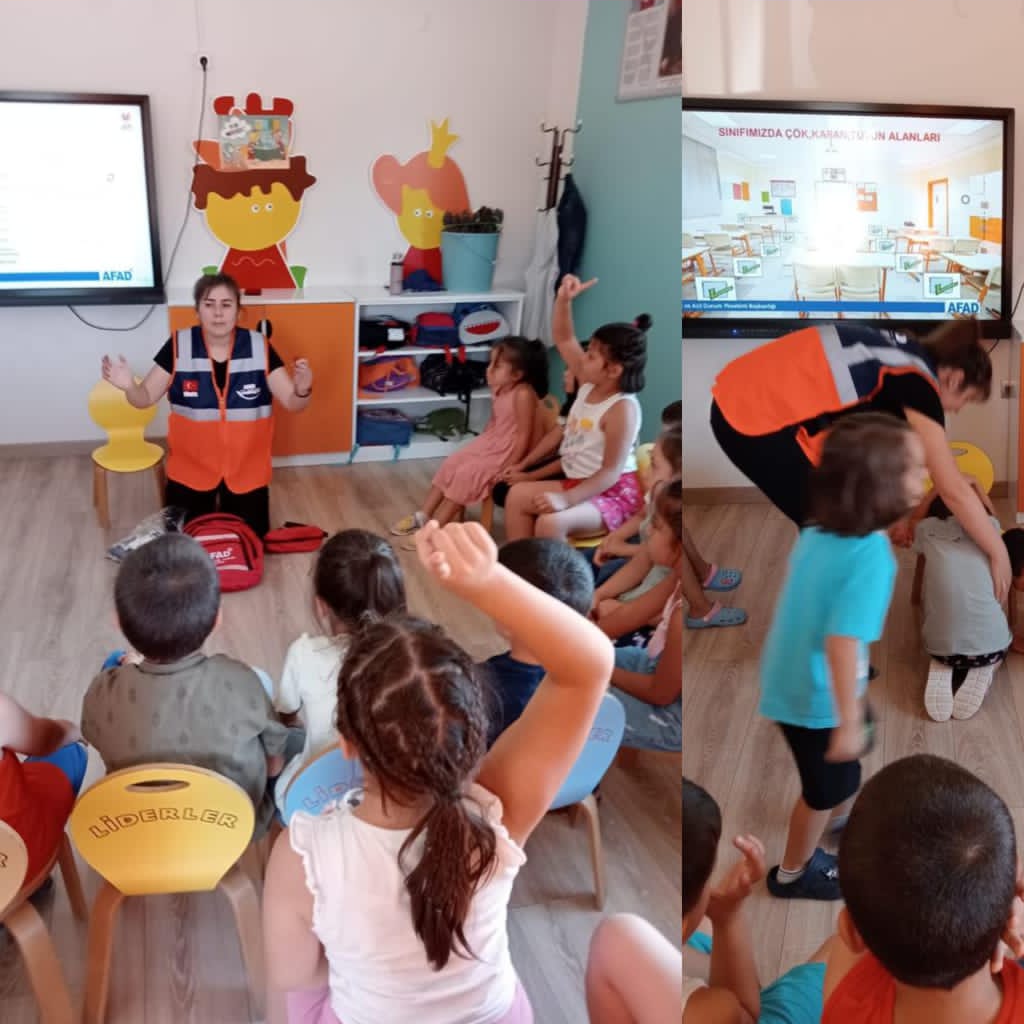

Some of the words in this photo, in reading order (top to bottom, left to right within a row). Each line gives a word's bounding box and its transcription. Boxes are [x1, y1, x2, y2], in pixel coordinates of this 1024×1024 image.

[888, 132, 941, 143] ALANLARI
[103, 270, 133, 281] AFAD
[947, 301, 980, 313] AFAD
[209, 548, 233, 560] FAD
